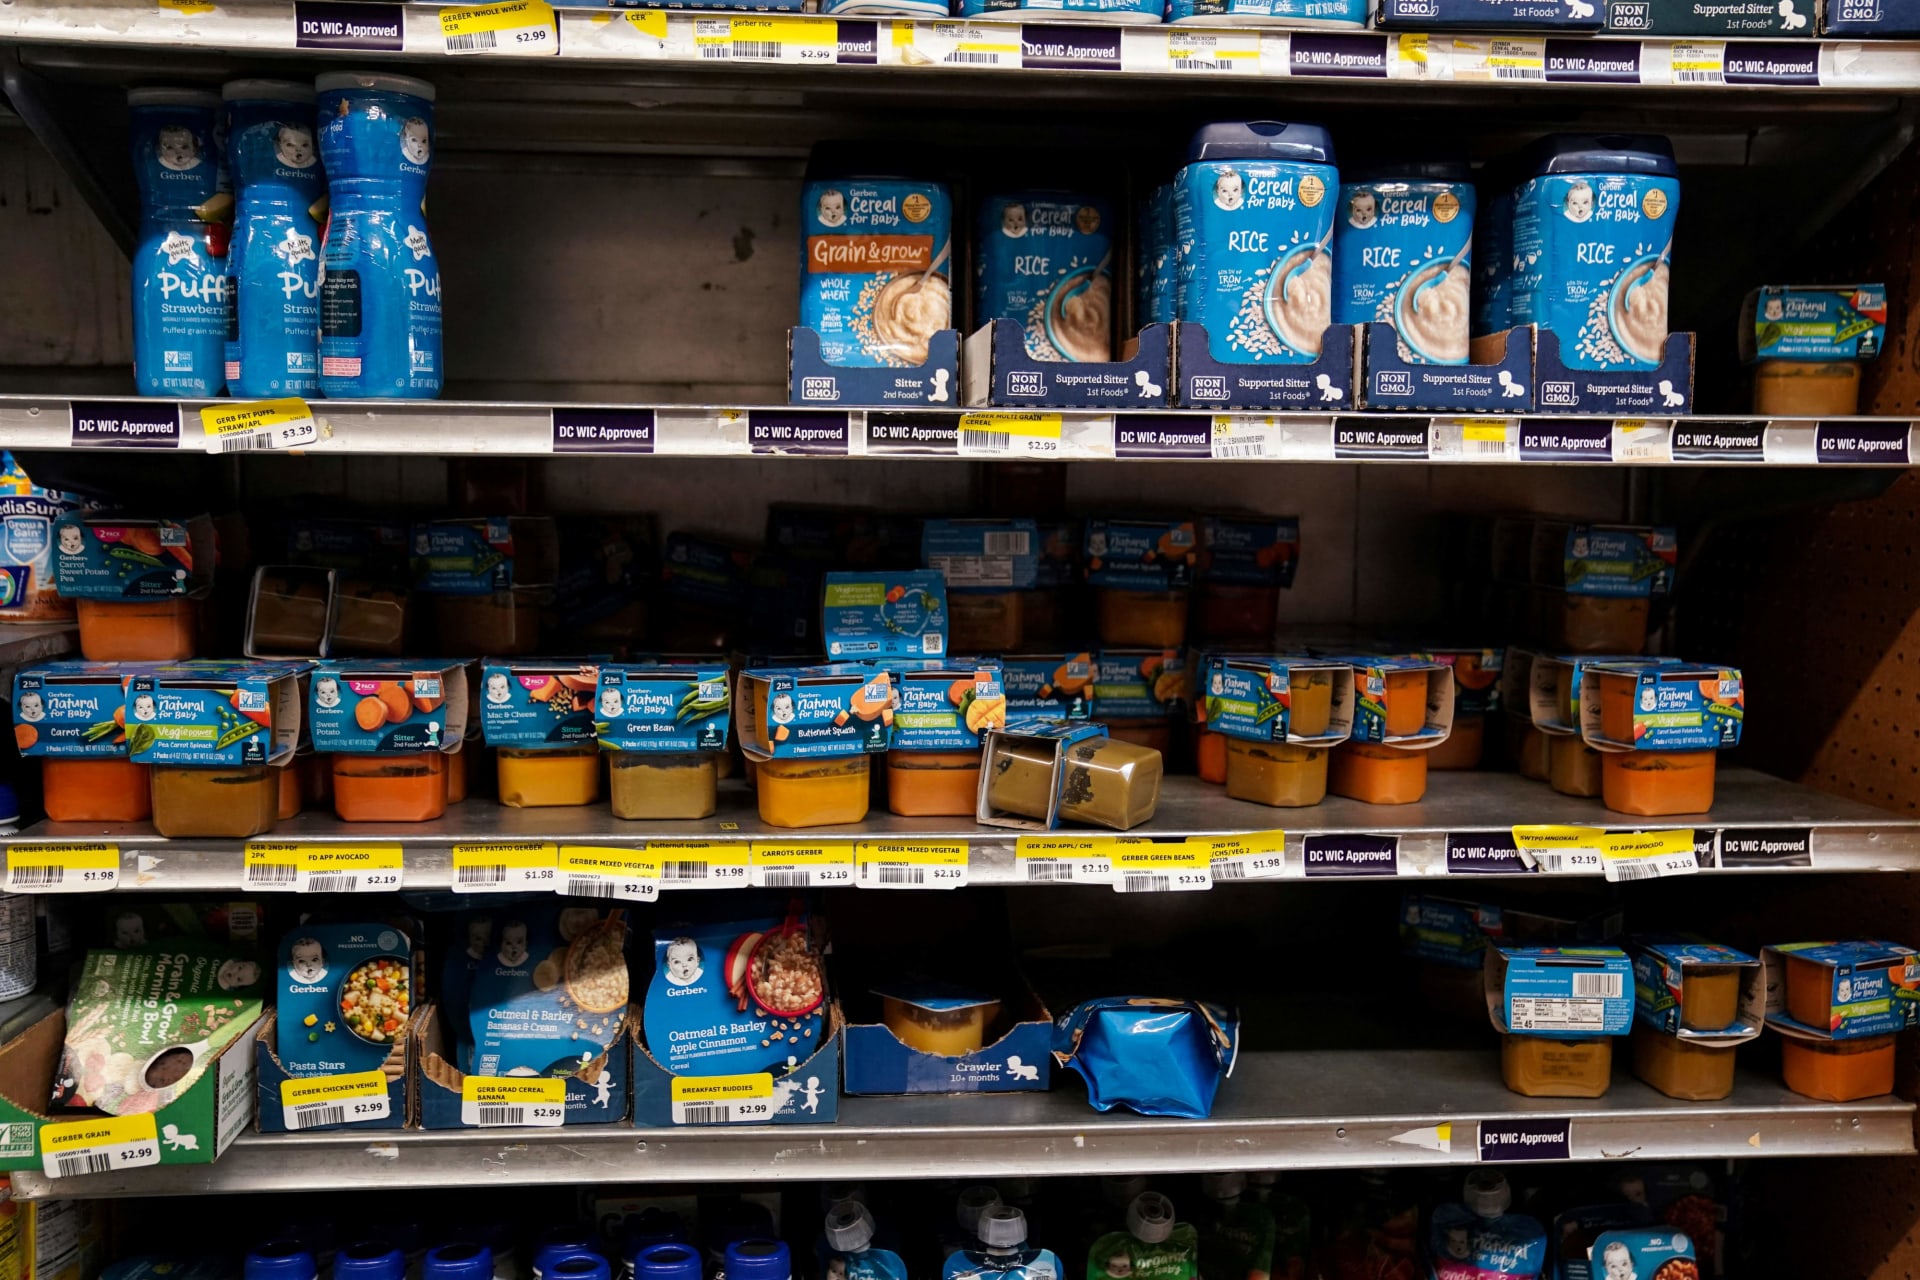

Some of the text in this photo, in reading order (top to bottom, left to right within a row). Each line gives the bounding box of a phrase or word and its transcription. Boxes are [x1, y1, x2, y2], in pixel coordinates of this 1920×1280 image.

[1613, 6, 1643, 16] NON
[1693, 4, 1773, 15] Supported Sitter
[733, 19, 773, 28] gerber rice
[302, 22, 397, 38] DC WIC Approved
[516, 30, 546, 43] $2.99
[800, 50, 830, 59] $2.99
[1295, 51, 1381, 67] DC WIC Approved
[1729, 61, 1813, 76] DC WIC Approved
[160, 171, 202, 182] Gerber
[1248, 178, 1292, 195] Cereal
[850, 196, 896, 213] Cereal
[1247, 195, 1296, 211] for Baby
[1381, 196, 1427, 213] Cereal
[1598, 190, 1637, 208] Cereal
[850, 213, 900, 226] for Baby
[1031, 208, 1072, 225] Cereal
[1379, 213, 1430, 228] for Baby
[1595, 207, 1641, 224] for Baby
[1228, 231, 1269, 253] RICE
[1362, 247, 1402, 267] RICE
[1577, 243, 1616, 264] RICE
[1015, 255, 1050, 275] RICE
[820, 278, 850, 290] WHOLE
[820, 290, 850, 302] WHEAT
[895, 379, 923, 388] Sitter
[1012, 375, 1037, 383] NON
[1056, 374, 1129, 385] Supported Sitter
[1195, 378, 1220, 387] NON
[1238, 378, 1311, 388] Supported Sitter
[1380, 374, 1405, 383] NON
[1423, 373, 1492, 385] Supported Sitter
[807, 380, 831, 389] NON
[1546, 385, 1570, 394] NON
[1587, 384, 1654, 395] Supported Sitter
[965, 419, 991, 427] CEREAL
[282, 425, 313, 440] $3.39
[559, 426, 648, 440] DC WIC Approved
[1120, 431, 1206, 445] DC WIC Approved
[1028, 440, 1056, 451] $2.99
[1524, 435, 1606, 450] DC WIC Approved
[1822, 438, 1903, 452] DC WIC Approved
[627, 694, 674, 707] Natural
[903, 690, 944, 702] Natural
[1658, 690, 1693, 702] Natural
[48, 697, 99, 710] Natural
[158, 699, 204, 713] Natural
[798, 697, 841, 710] Natural
[50, 709, 92, 719] for Baby
[158, 710, 197, 720] for Baby
[628, 705, 667, 714] for Baby
[51, 728, 80, 737] Carrot
[627, 724, 674, 732] Green Bean
[686, 842, 709, 850] squash
[1212, 842, 1226, 850] 2ND
[1725, 839, 1804, 852] DC WIC Approved
[319, 853, 334, 861] APP
[336, 852, 370, 860] AVOCADO
[762, 849, 794, 857] CARROTS
[1253, 858, 1281, 868] $1.98
[1571, 855, 1597, 865] $2.19
[1666, 859, 1693, 869] $2.19
[715, 868, 744, 878] $1.98
[934, 869, 961, 878] $2.19
[1082, 864, 1109, 873] $2.19
[84, 871, 114, 881] $1.98
[367, 875, 396, 885] $2.19
[525, 870, 554, 880] $1.98
[820, 871, 848, 880] $2.19
[1178, 875, 1206, 884] $2.19
[625, 884, 654, 894] $2.19
[289, 984, 329, 994] Gerber
[1853, 977, 1883, 991] Natural
[488, 1008, 574, 1024] Oatmeal & Barley
[487, 1021, 558, 1032] Bananas & Cream
[1524, 1020, 1533, 1028] 45
[668, 1021, 767, 1042] Oatmeal & Barley
[670, 1037, 747, 1055] Apple Cinnamon
[289, 1060, 346, 1071] Pasta Stars
[956, 1062, 1001, 1073] Crawler
[951, 1073, 1000, 1082] 10+ months
[292, 1081, 379, 1097] GERBER CHICKEN VEHGE
[354, 1103, 383, 1113] $2.99
[533, 1108, 561, 1117] $2.99
[739, 1104, 767, 1114] $2.99
[52, 1130, 111, 1143] GERBER GRAIN
[1484, 1131, 1564, 1145] DC WIC Approved
[121, 1147, 152, 1161] $2.99
